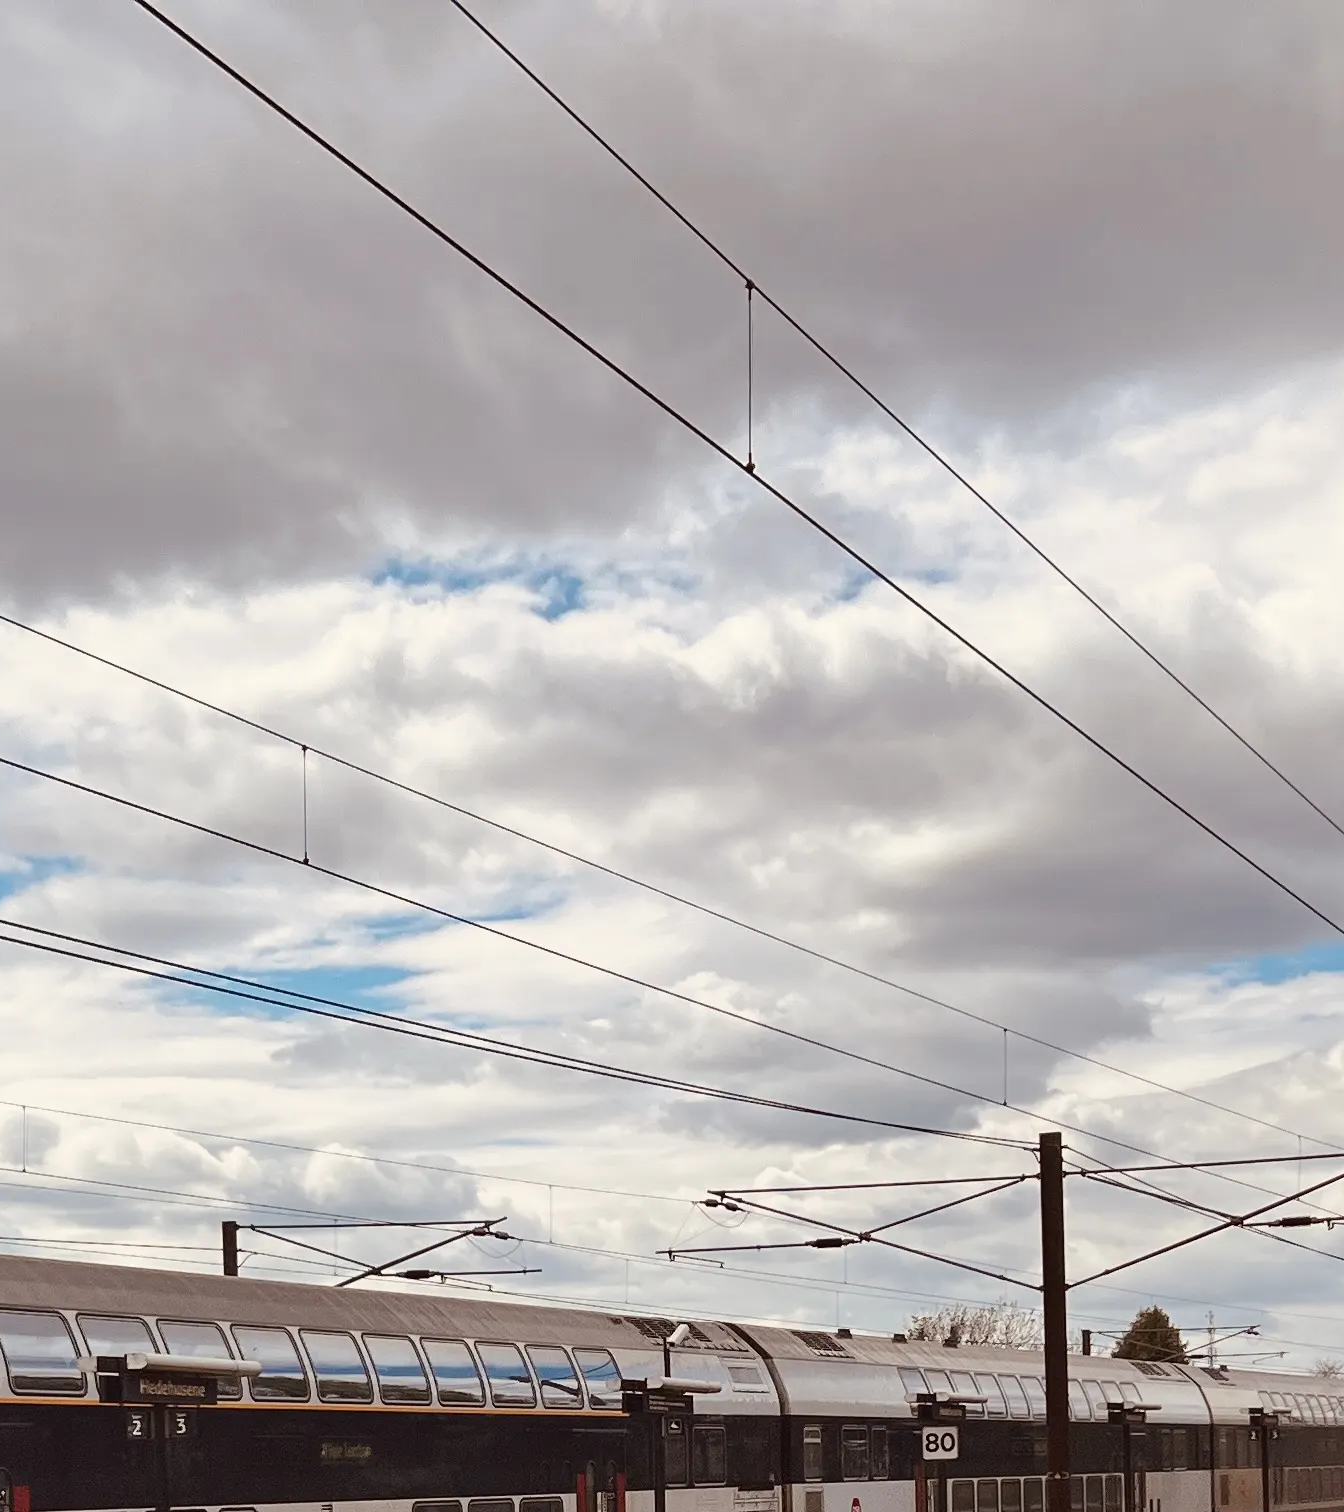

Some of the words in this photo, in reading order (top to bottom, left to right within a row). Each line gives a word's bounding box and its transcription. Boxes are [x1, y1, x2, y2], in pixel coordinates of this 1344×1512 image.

[139, 1379, 206, 1398] Hedehusene
[132, 1420, 142, 1436] 2
[176, 1418, 187, 1434] 3
[925, 1432, 956, 1453] 80
